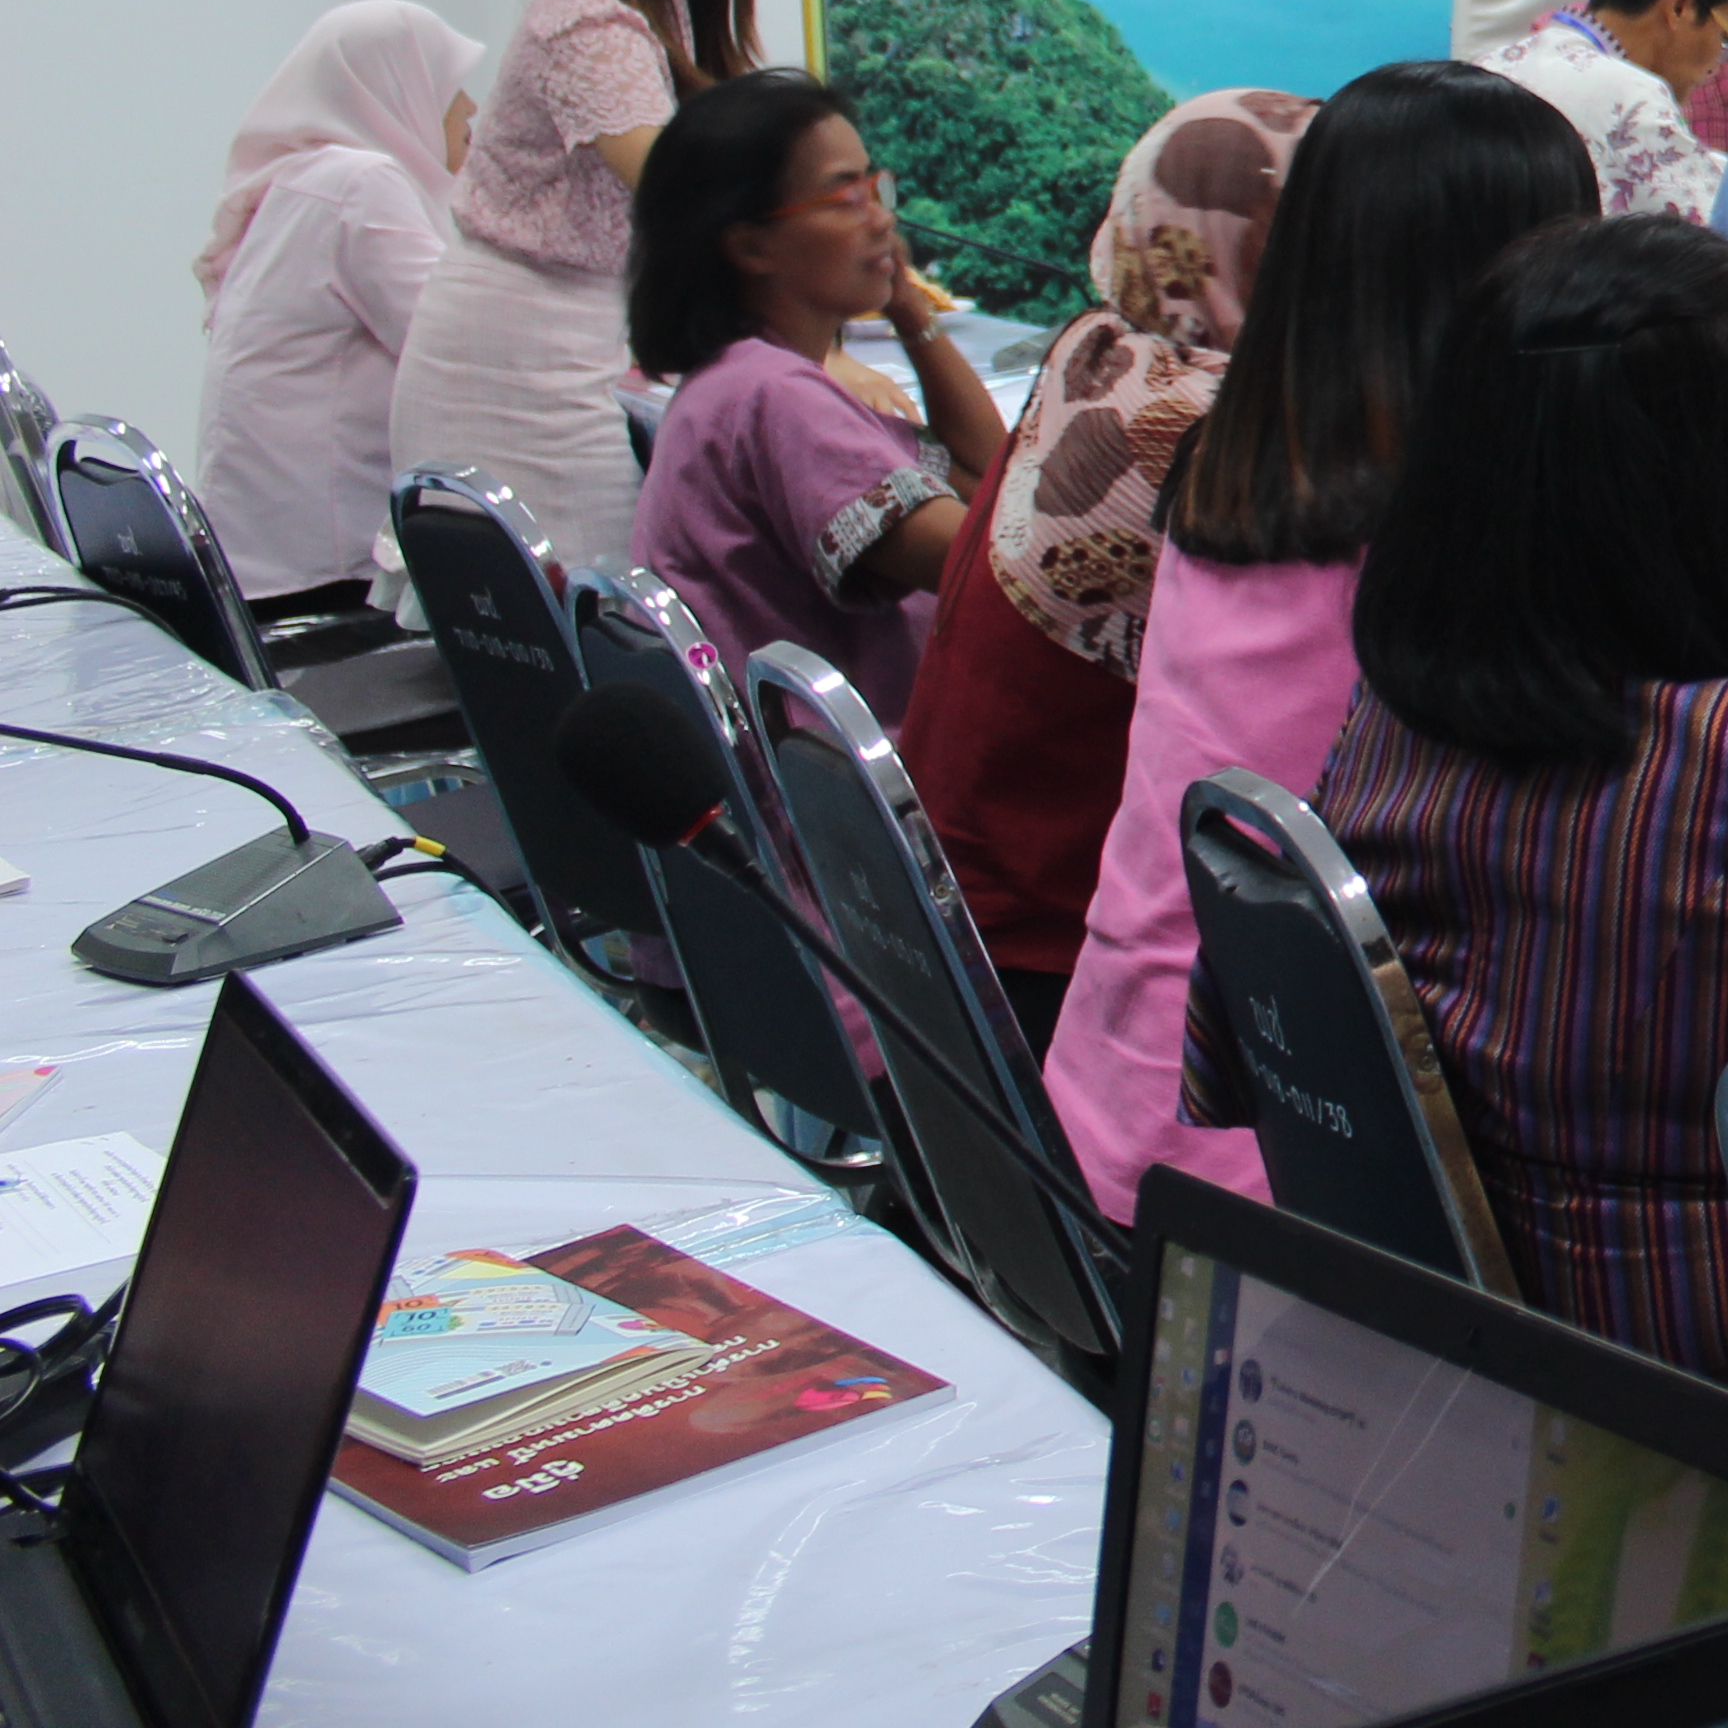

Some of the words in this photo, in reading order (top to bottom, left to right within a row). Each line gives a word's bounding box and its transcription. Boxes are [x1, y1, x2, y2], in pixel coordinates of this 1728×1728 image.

[506, 1384, 707, 1466] การติดตามหนี้
[435, 1456, 501, 1483] และ
[481, 1458, 585, 1500] คู่มือ
